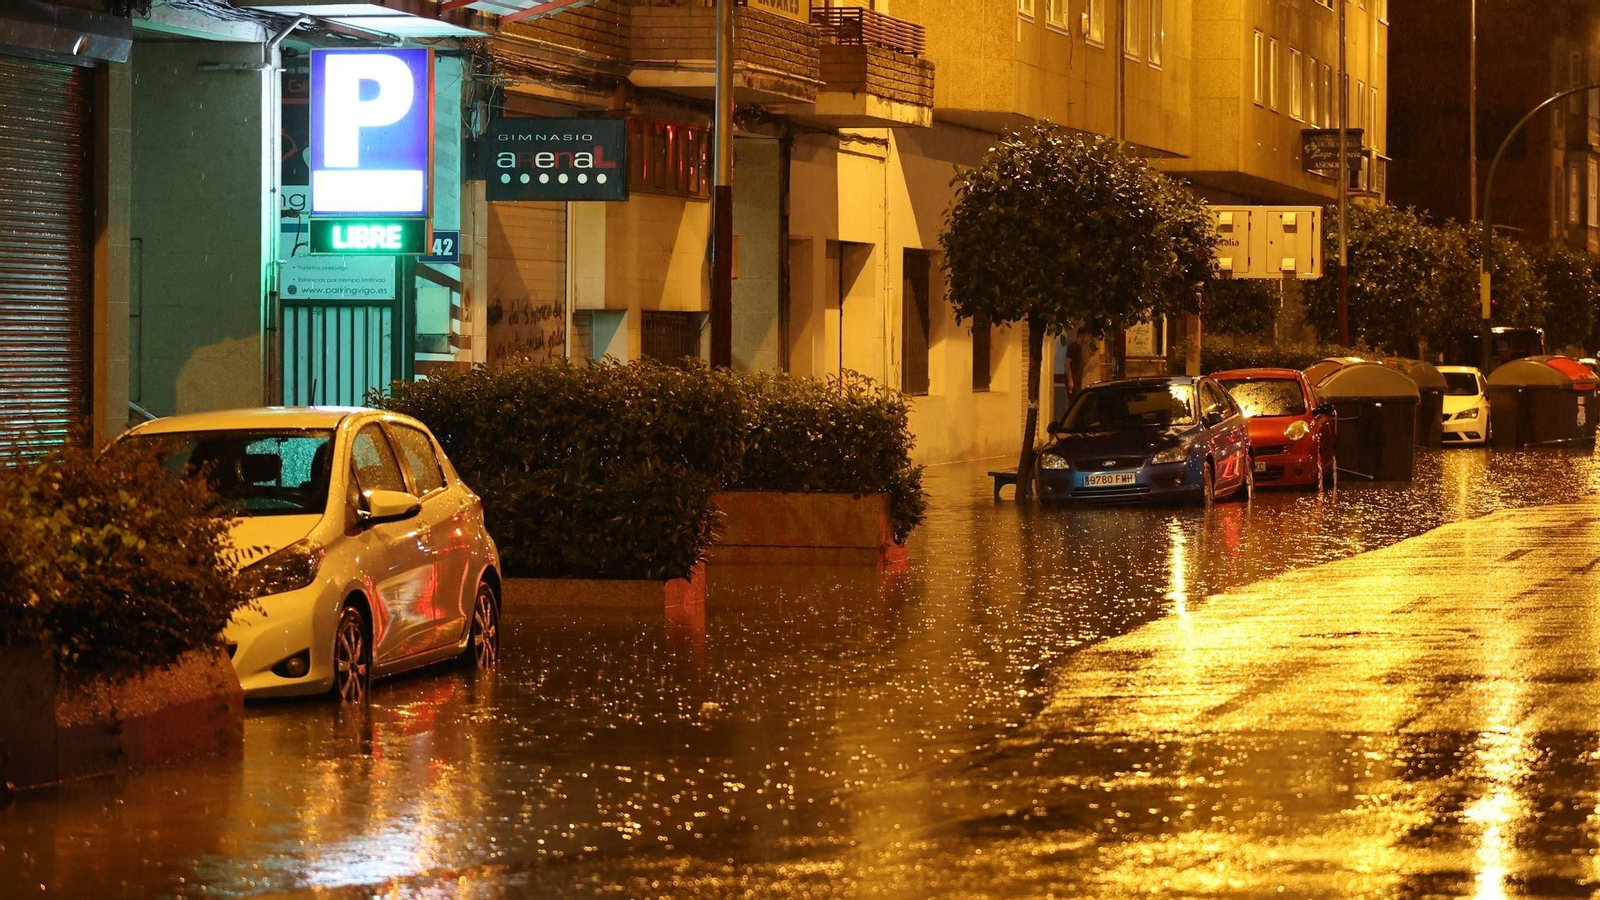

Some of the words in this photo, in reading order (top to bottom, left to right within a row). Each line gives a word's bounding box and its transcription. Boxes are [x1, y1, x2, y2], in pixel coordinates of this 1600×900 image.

[324, 54, 414, 167] P
[332, 225, 403, 249] LIBRE
[432, 238, 453, 256] 42
[301, 286, 388, 295] www.parkingvigo.es
[1089, 475, 1113, 485] 9780
